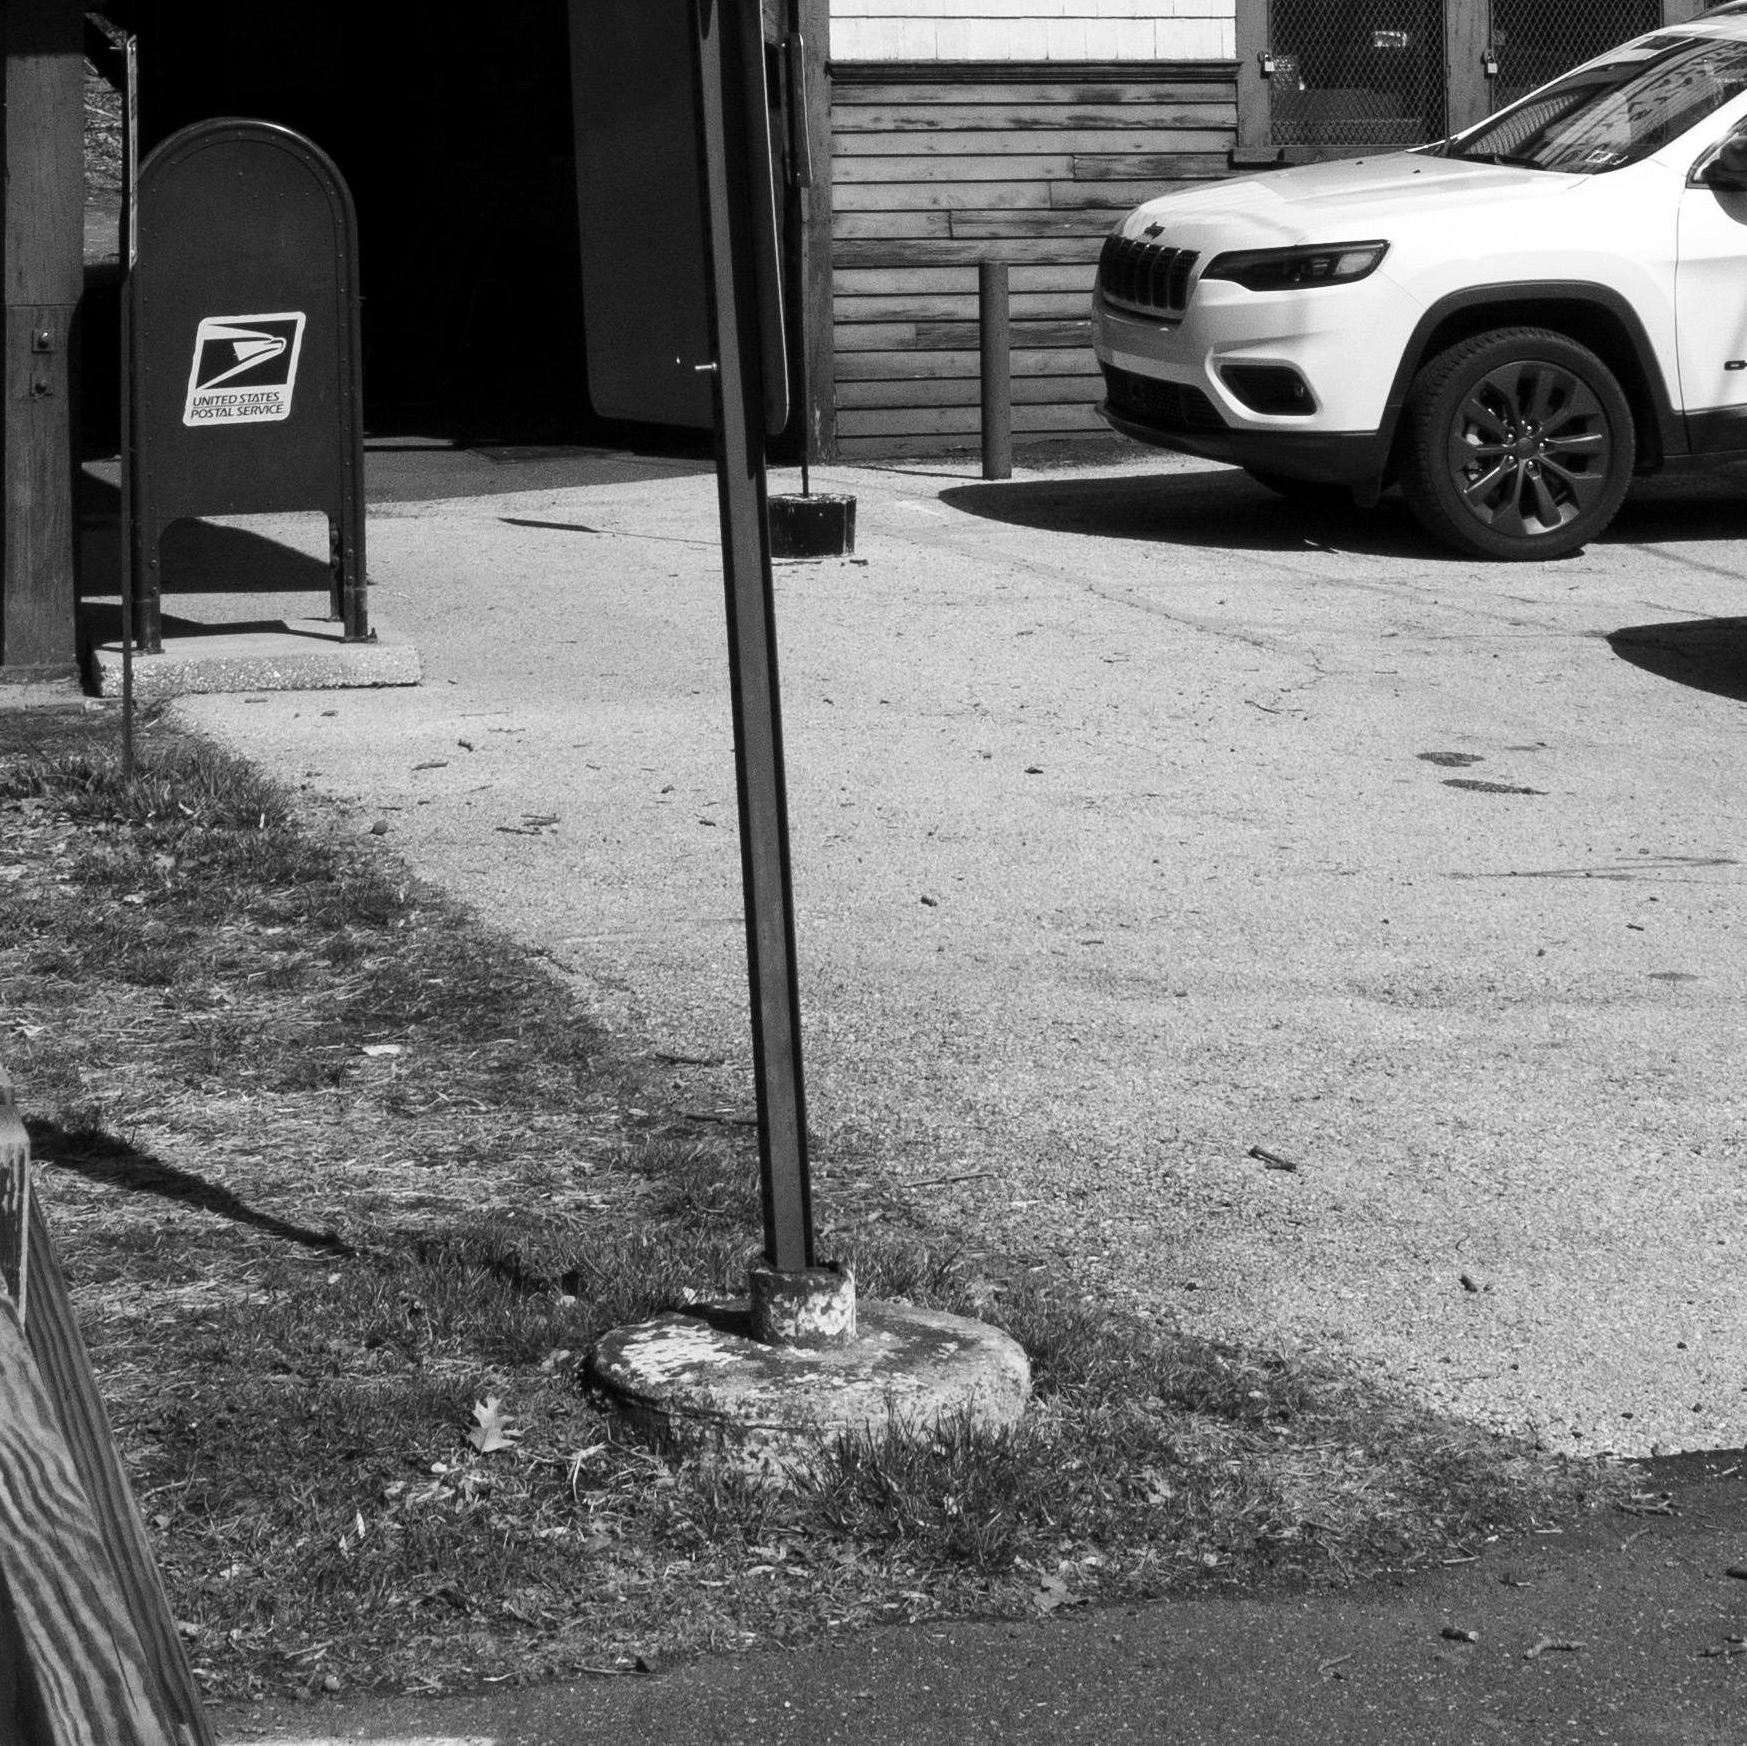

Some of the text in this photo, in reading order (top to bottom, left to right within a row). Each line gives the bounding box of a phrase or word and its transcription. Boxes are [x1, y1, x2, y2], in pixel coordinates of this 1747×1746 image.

[192, 391, 280, 407] UNITED STATES
[190, 403, 284, 419] POSTAL SERVICE
